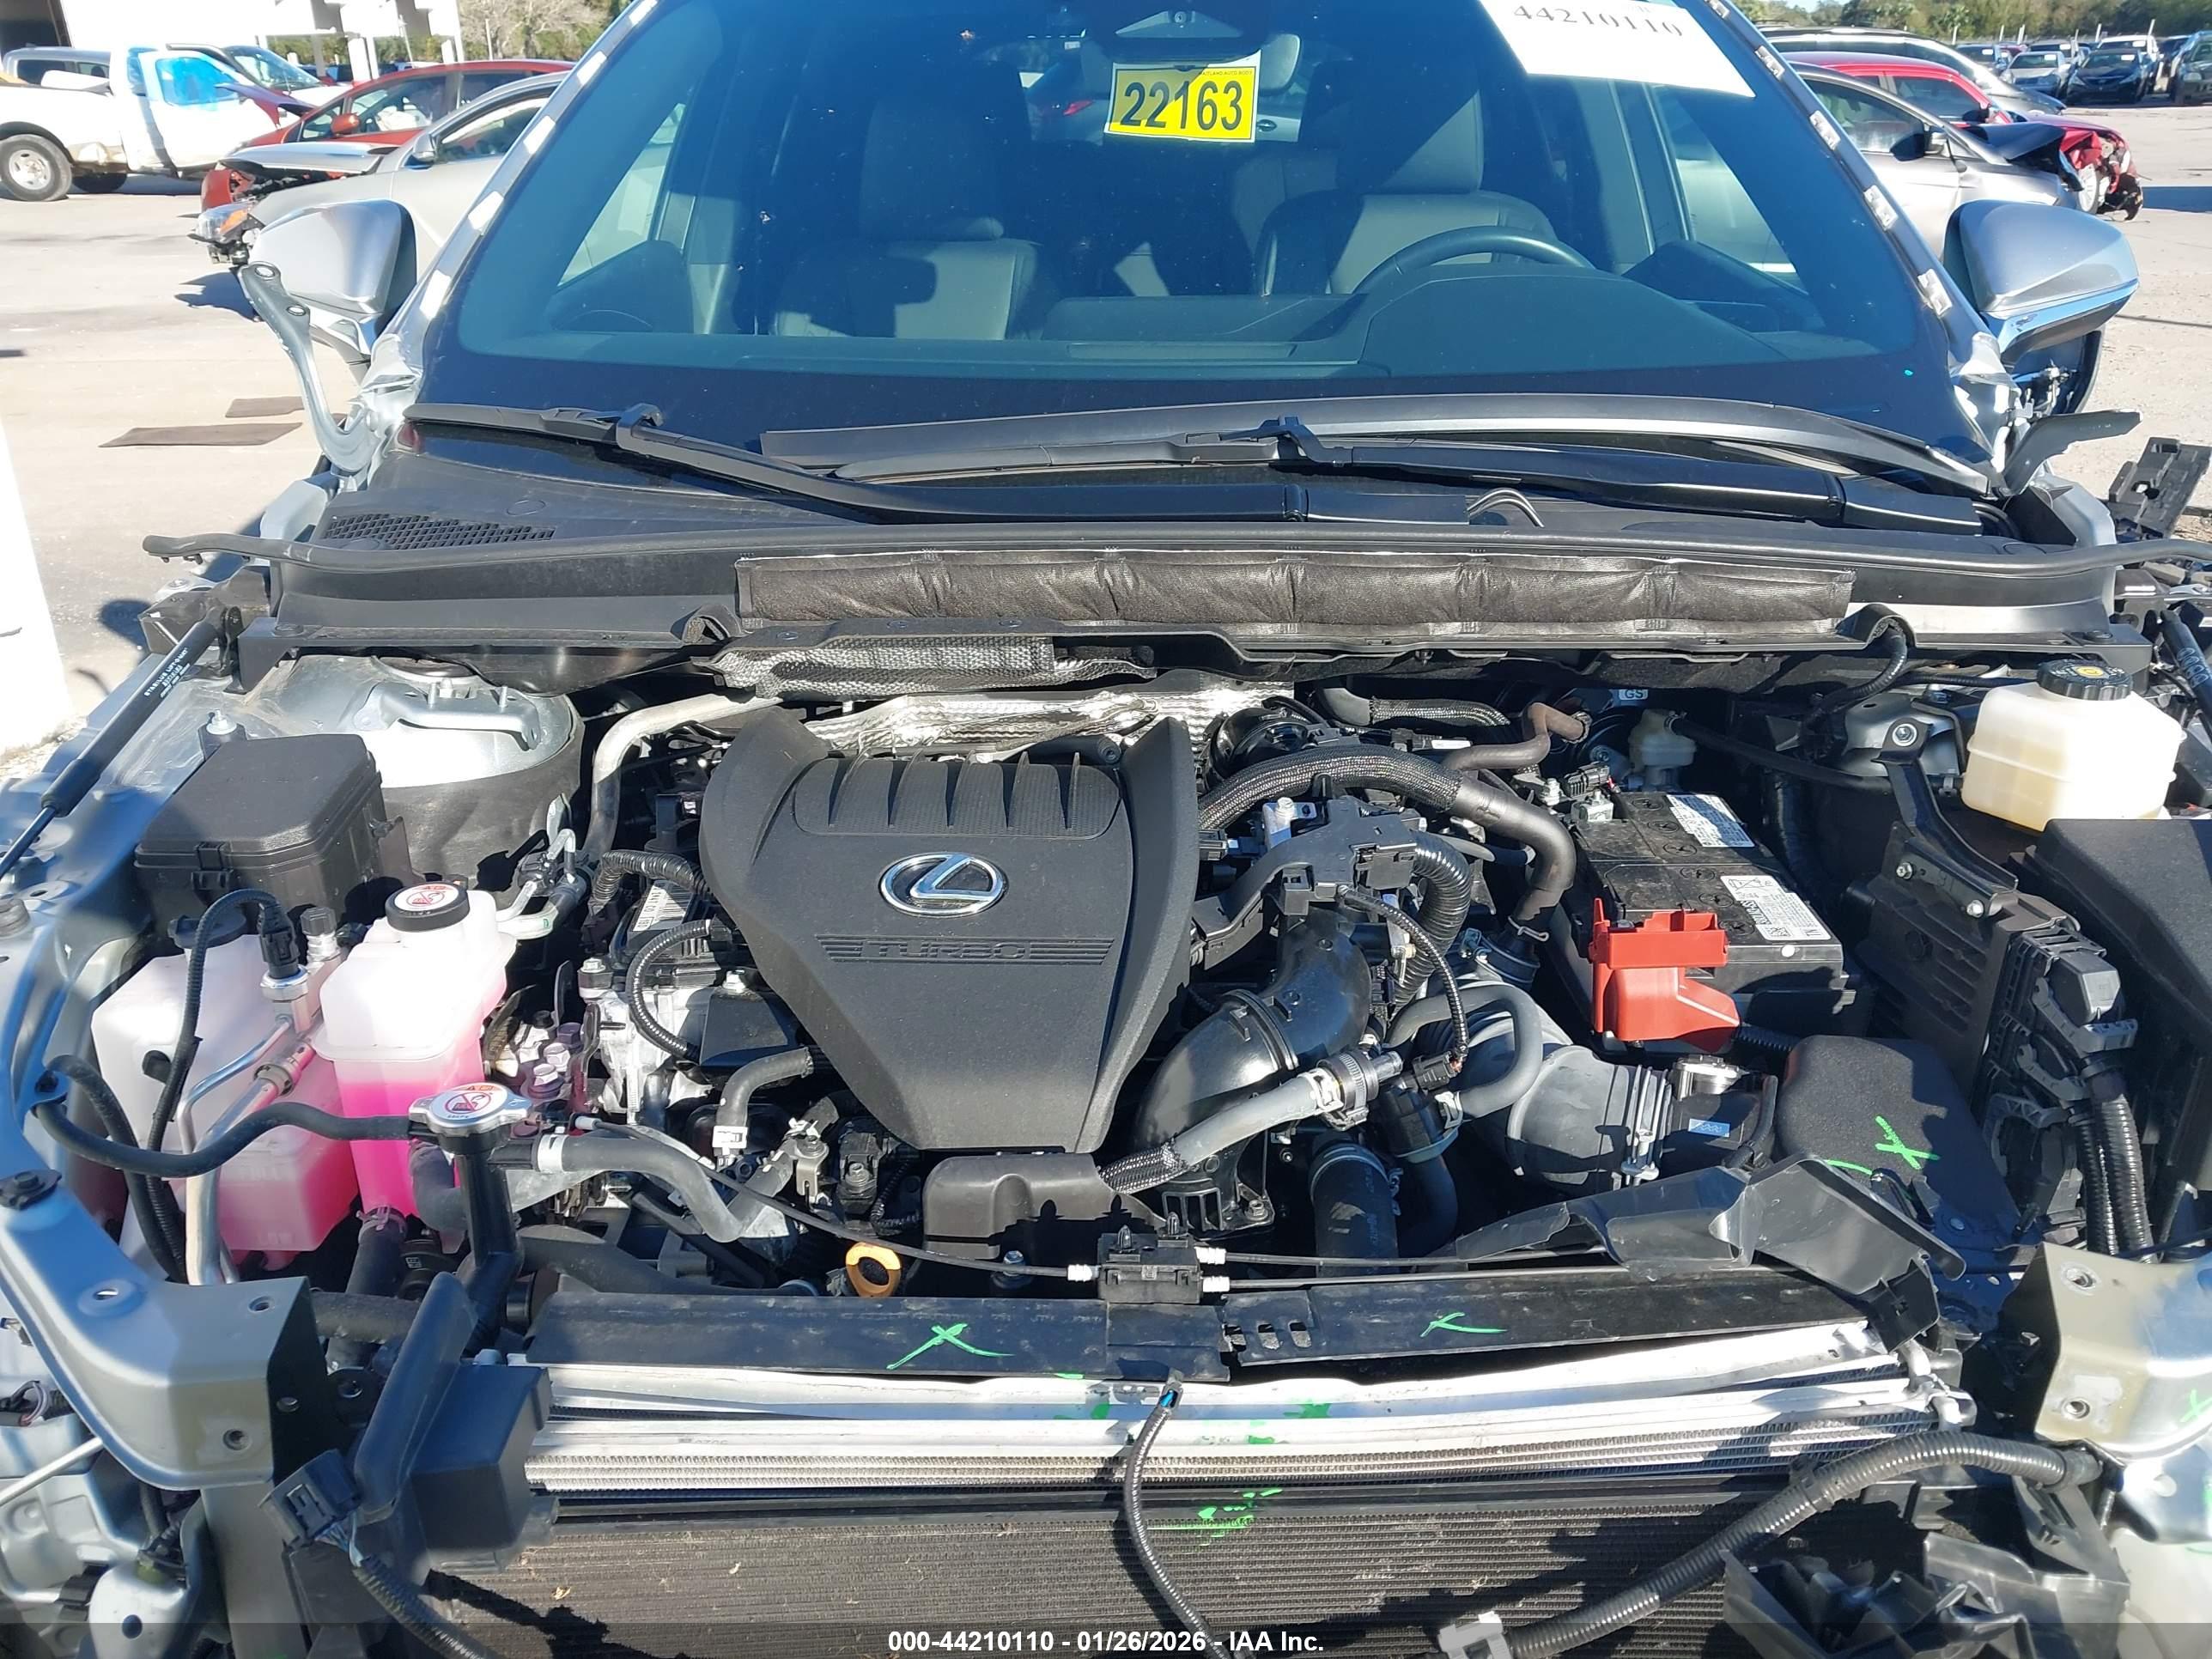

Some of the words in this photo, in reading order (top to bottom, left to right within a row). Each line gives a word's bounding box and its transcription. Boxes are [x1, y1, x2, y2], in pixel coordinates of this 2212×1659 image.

[1514, 5, 1682, 36] 44210110
[1120, 81, 1242, 131] 22163
[866, 940, 1025, 958] TURBO
